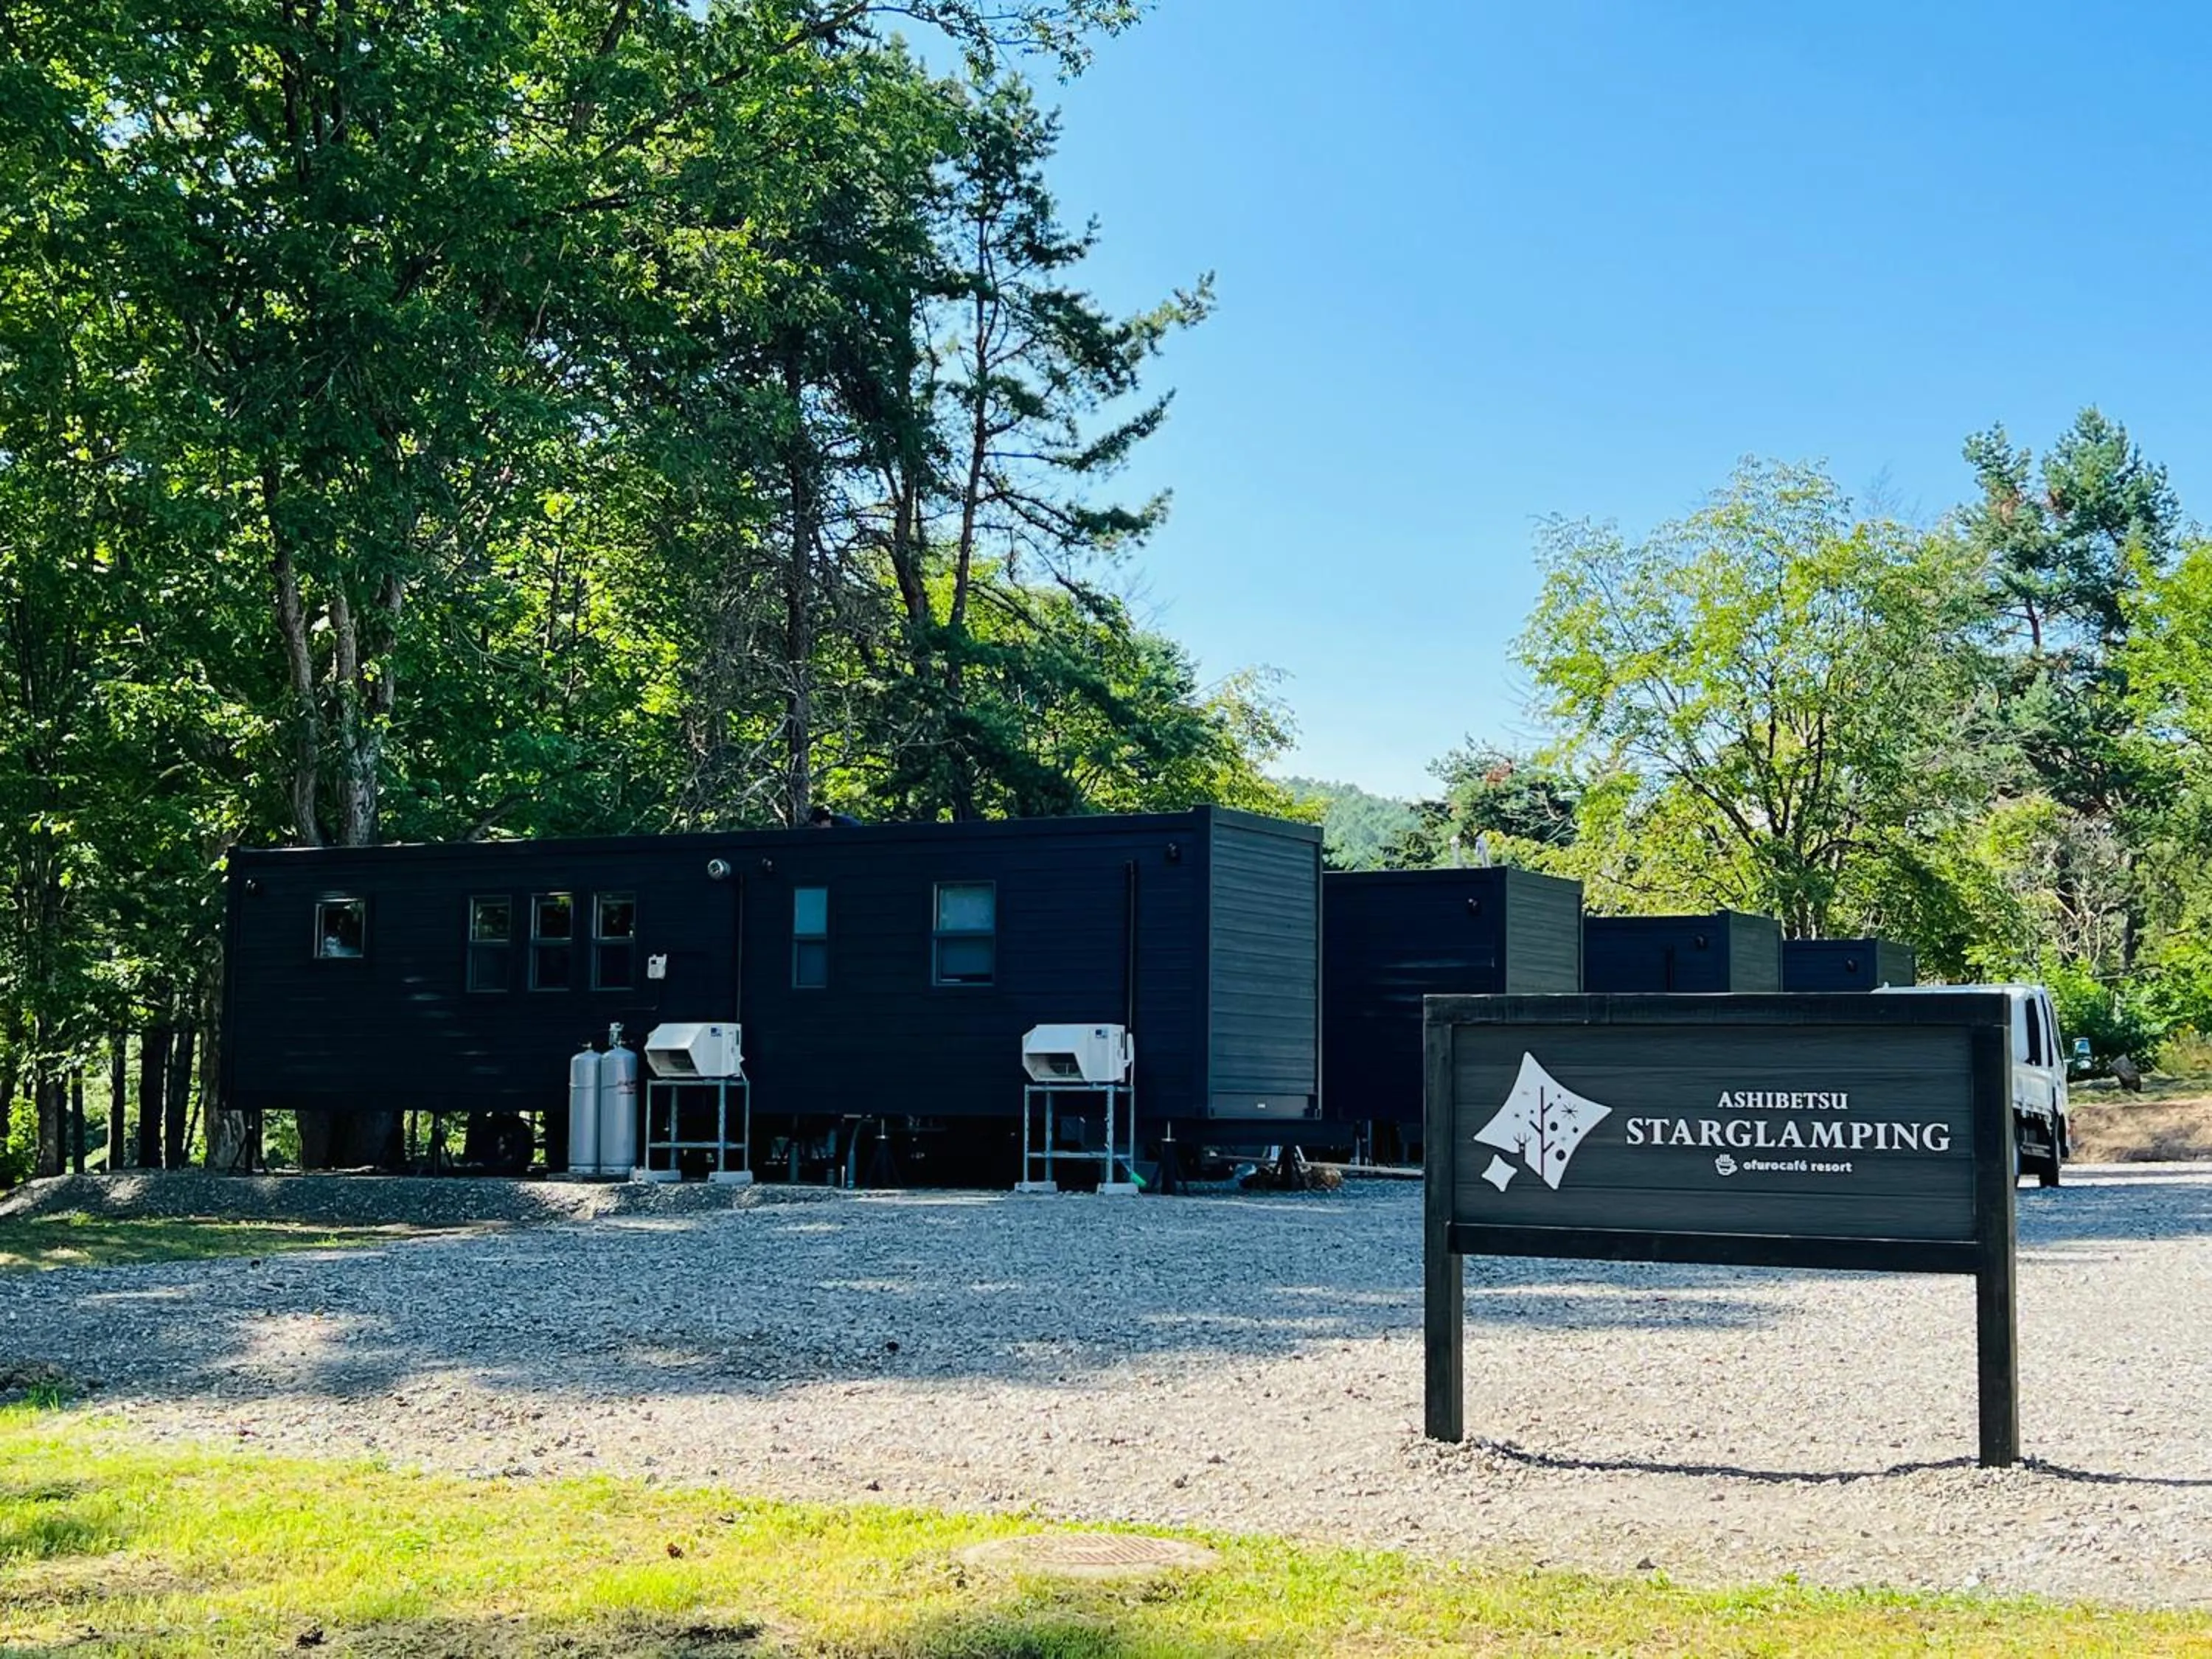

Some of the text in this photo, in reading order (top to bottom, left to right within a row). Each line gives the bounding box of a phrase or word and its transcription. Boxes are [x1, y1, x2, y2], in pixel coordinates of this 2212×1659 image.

[1717, 1091, 1848, 1110] ASHIBETSU
[1626, 1117, 1951, 1151] STARGLAMPING
[1742, 1159, 1853, 1172] ofurocafé resort
